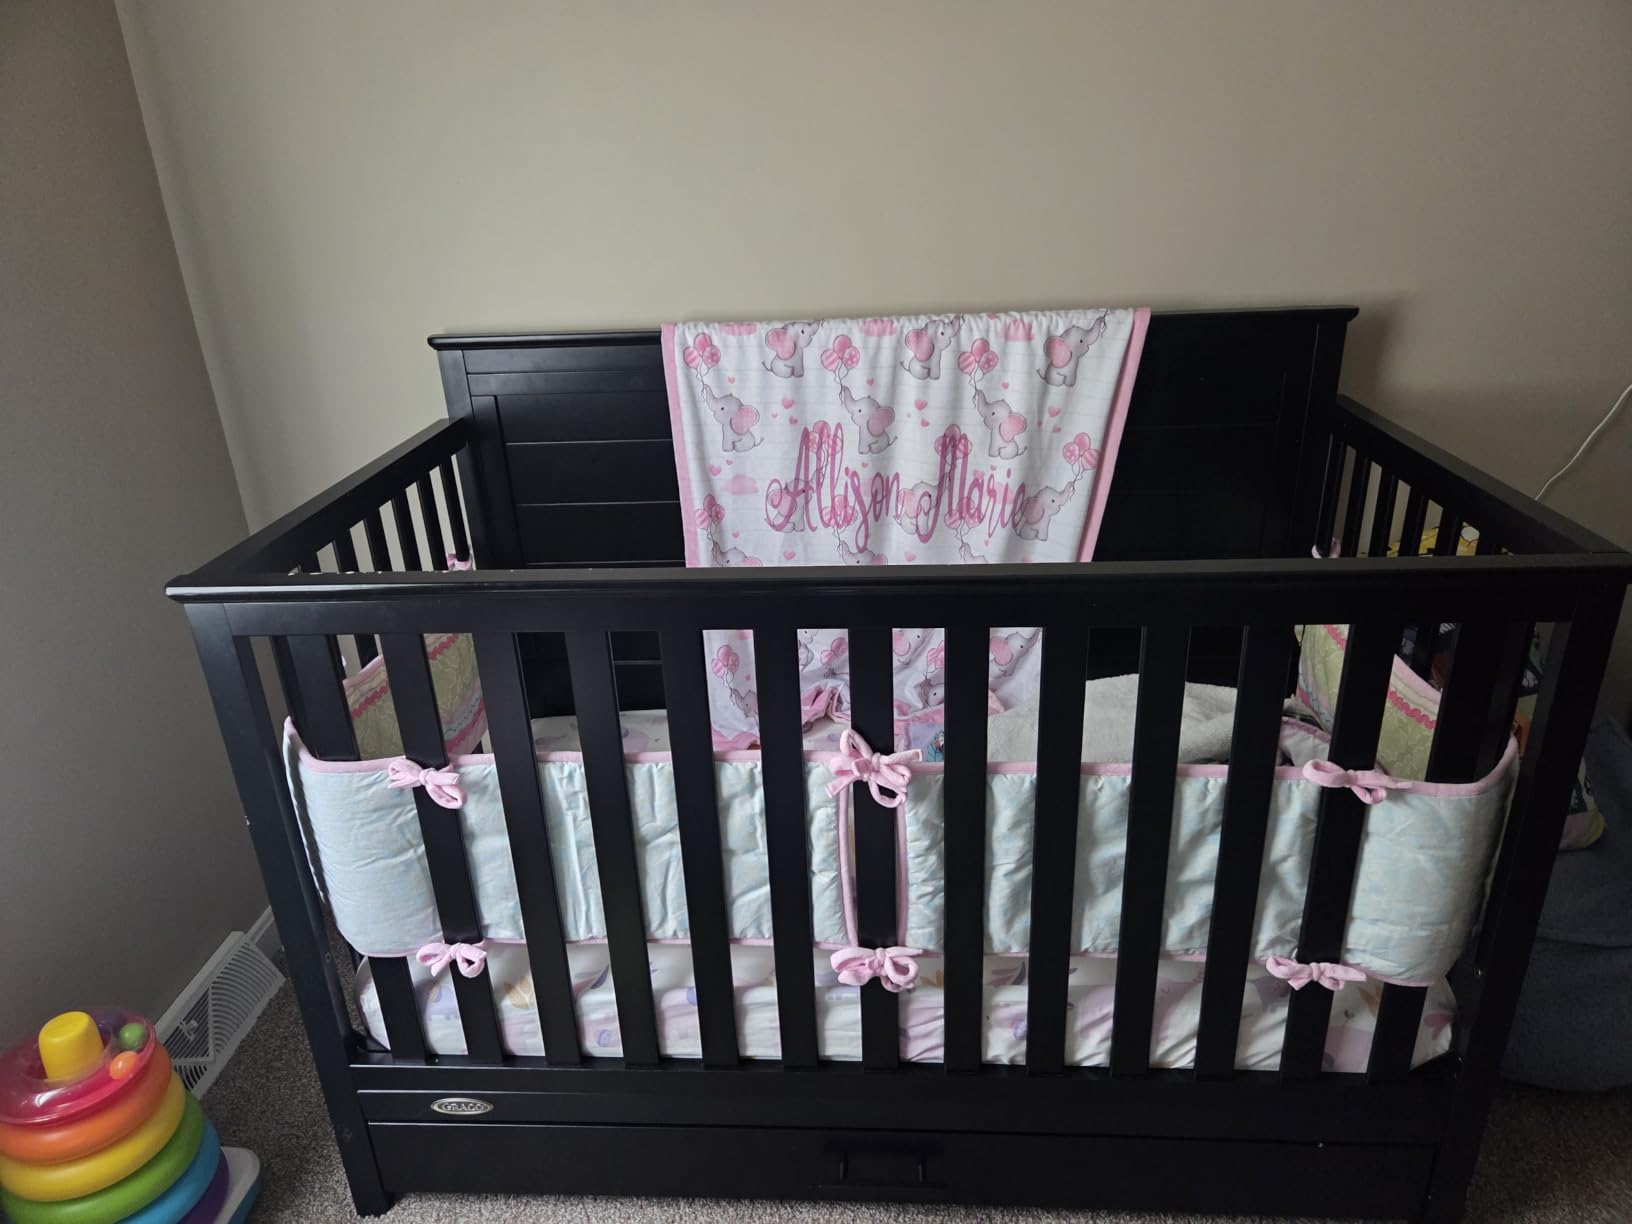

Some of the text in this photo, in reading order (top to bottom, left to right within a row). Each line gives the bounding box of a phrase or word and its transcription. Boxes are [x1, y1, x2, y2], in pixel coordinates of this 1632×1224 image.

[765, 421, 1025, 553] Allison Marie
[442, 1102, 485, 1112] GRACO
